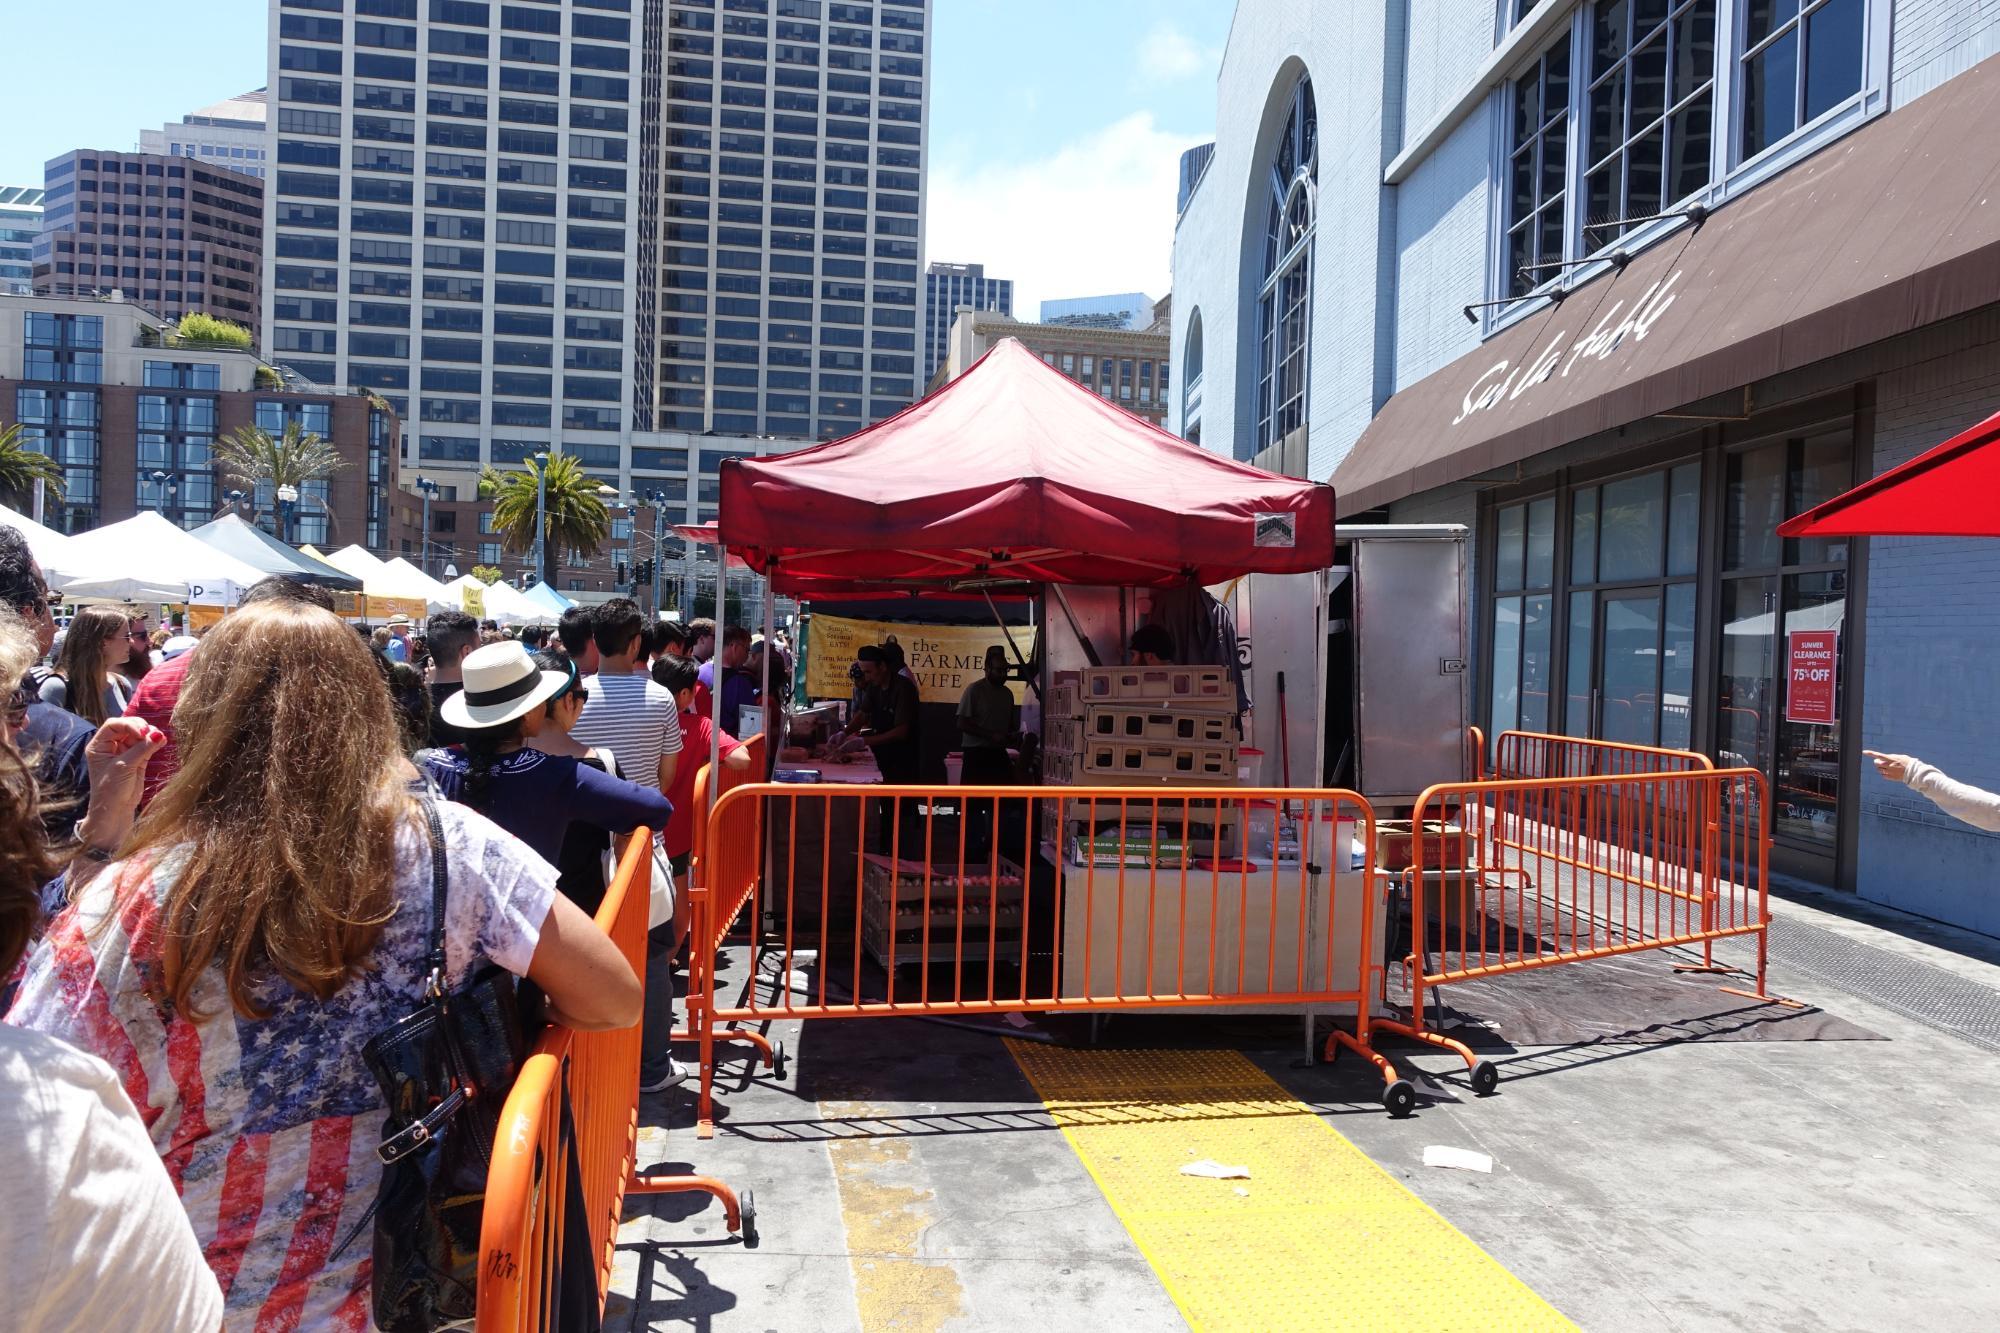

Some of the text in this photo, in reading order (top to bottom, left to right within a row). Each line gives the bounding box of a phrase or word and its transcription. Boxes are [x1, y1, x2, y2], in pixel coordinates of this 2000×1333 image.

[1452, 270, 1682, 425] Sur la table
[913, 639, 939, 652] the
[1793, 651, 1831, 659] CLEARANCE
